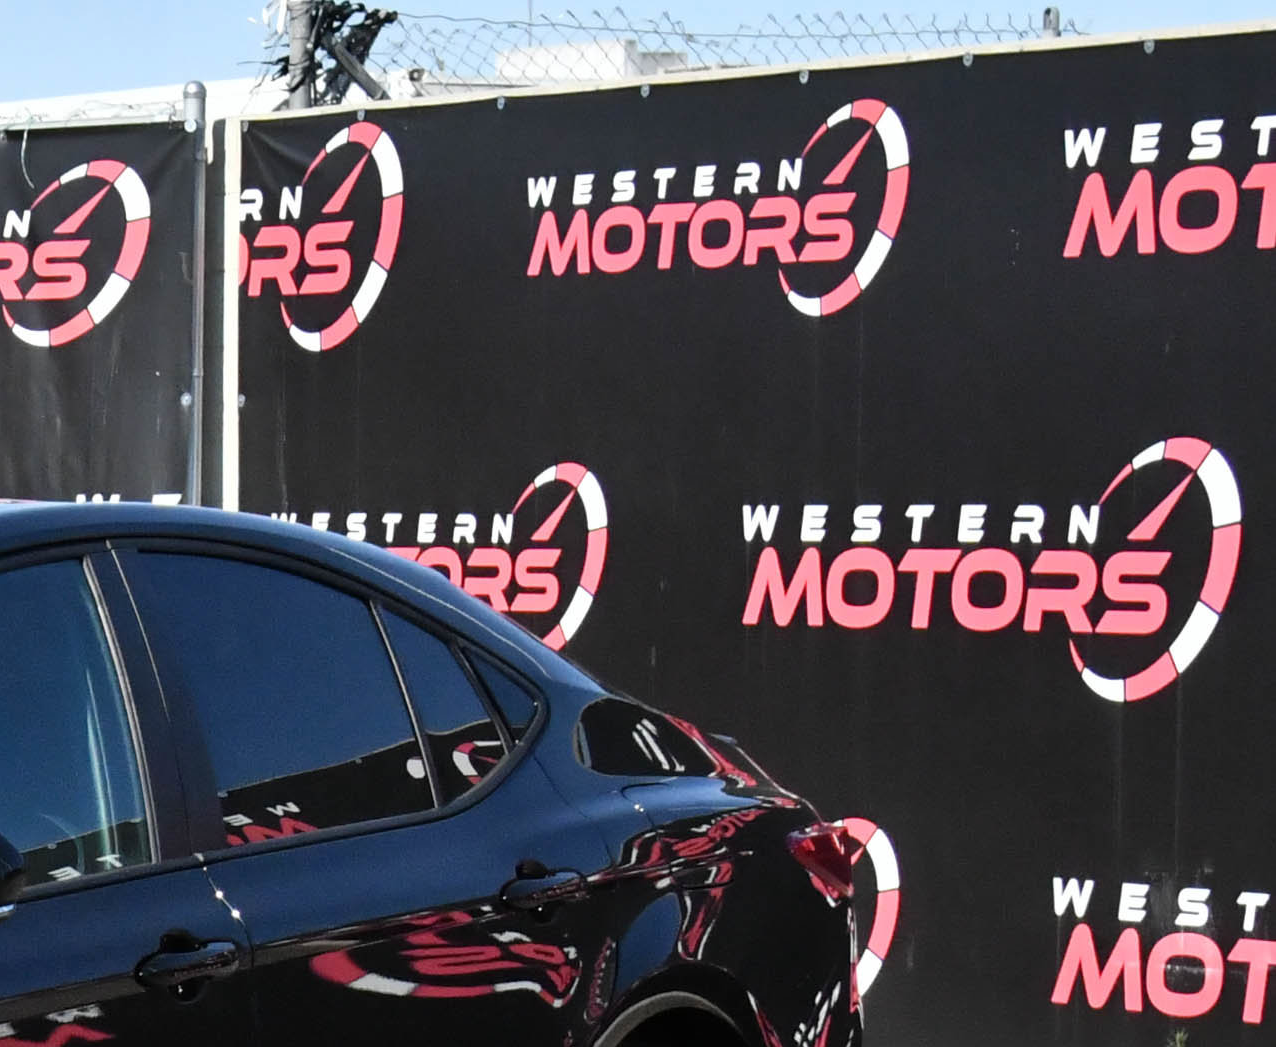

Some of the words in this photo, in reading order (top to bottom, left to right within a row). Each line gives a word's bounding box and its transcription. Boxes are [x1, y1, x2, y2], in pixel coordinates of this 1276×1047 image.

[1064, 114, 1276, 169] WEST
[527, 157, 803, 209] WESTERN
[1062, 162, 1276, 259] MOT
[526, 191, 857, 277] MOTORS
[742, 504, 1100, 545] WESTERN
[741, 546, 1173, 636] MOTORS
[1052, 877, 1270, 932] WEST
[1050, 922, 1276, 1025] MOT
